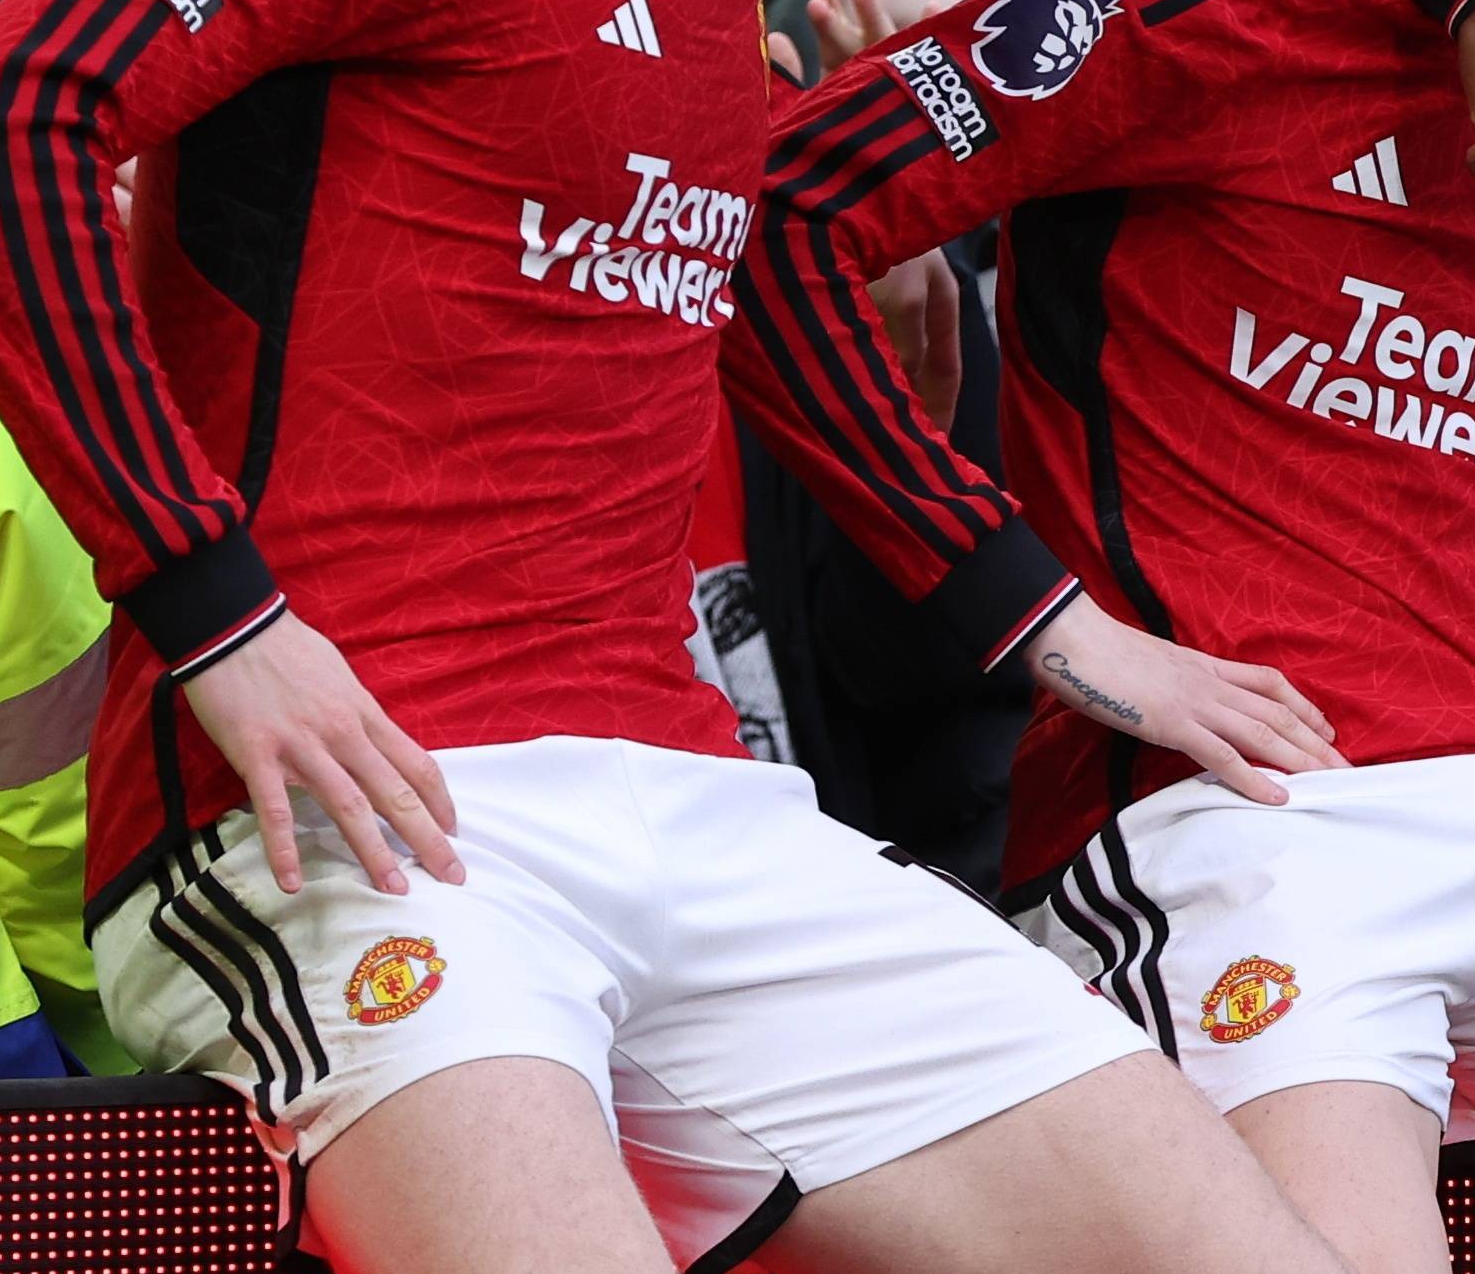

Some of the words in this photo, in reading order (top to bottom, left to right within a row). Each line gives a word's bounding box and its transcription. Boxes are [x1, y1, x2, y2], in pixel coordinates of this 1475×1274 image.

[909, 72, 973, 162] racism
[914, 36, 943, 66] No
[931, 63, 987, 139] room
[618, 152, 748, 260] Team
[519, 198, 723, 327] Viewer
[1042, 652, 1144, 725] Concepción
[350, 941, 429, 994] MANCHESTER
[374, 987, 431, 1021] UNITED
[1209, 962, 1287, 1006] MANCHESTER
[1223, 1010, 1278, 1039] UNITED
